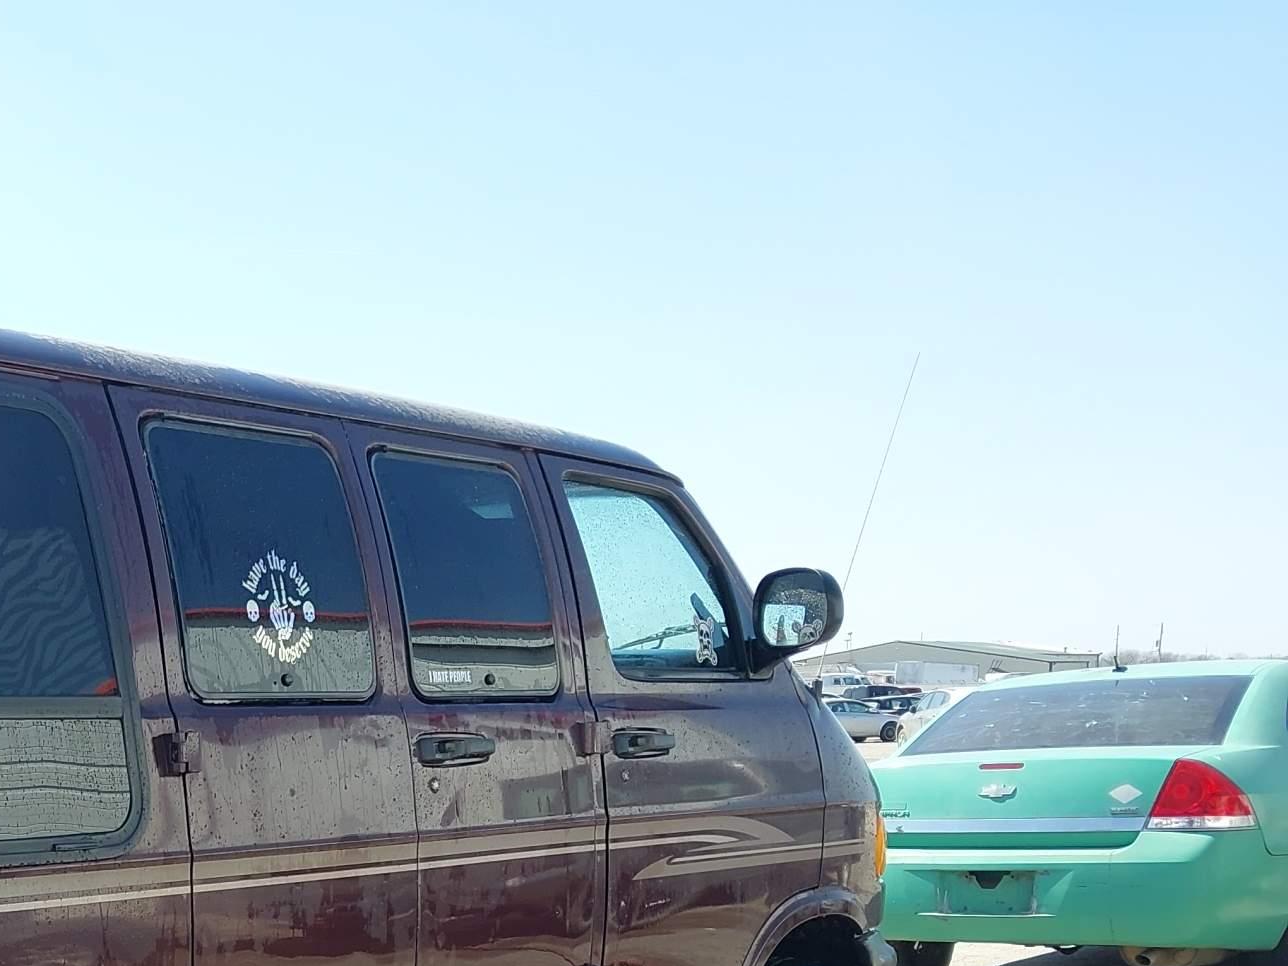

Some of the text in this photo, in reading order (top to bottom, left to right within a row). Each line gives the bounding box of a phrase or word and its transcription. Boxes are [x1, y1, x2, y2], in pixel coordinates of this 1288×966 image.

[242, 549, 311, 597] have the day
[252, 625, 314, 665] you deserve
[433, 671, 450, 683] HATE
[449, 670, 472, 684] PEOPLE
